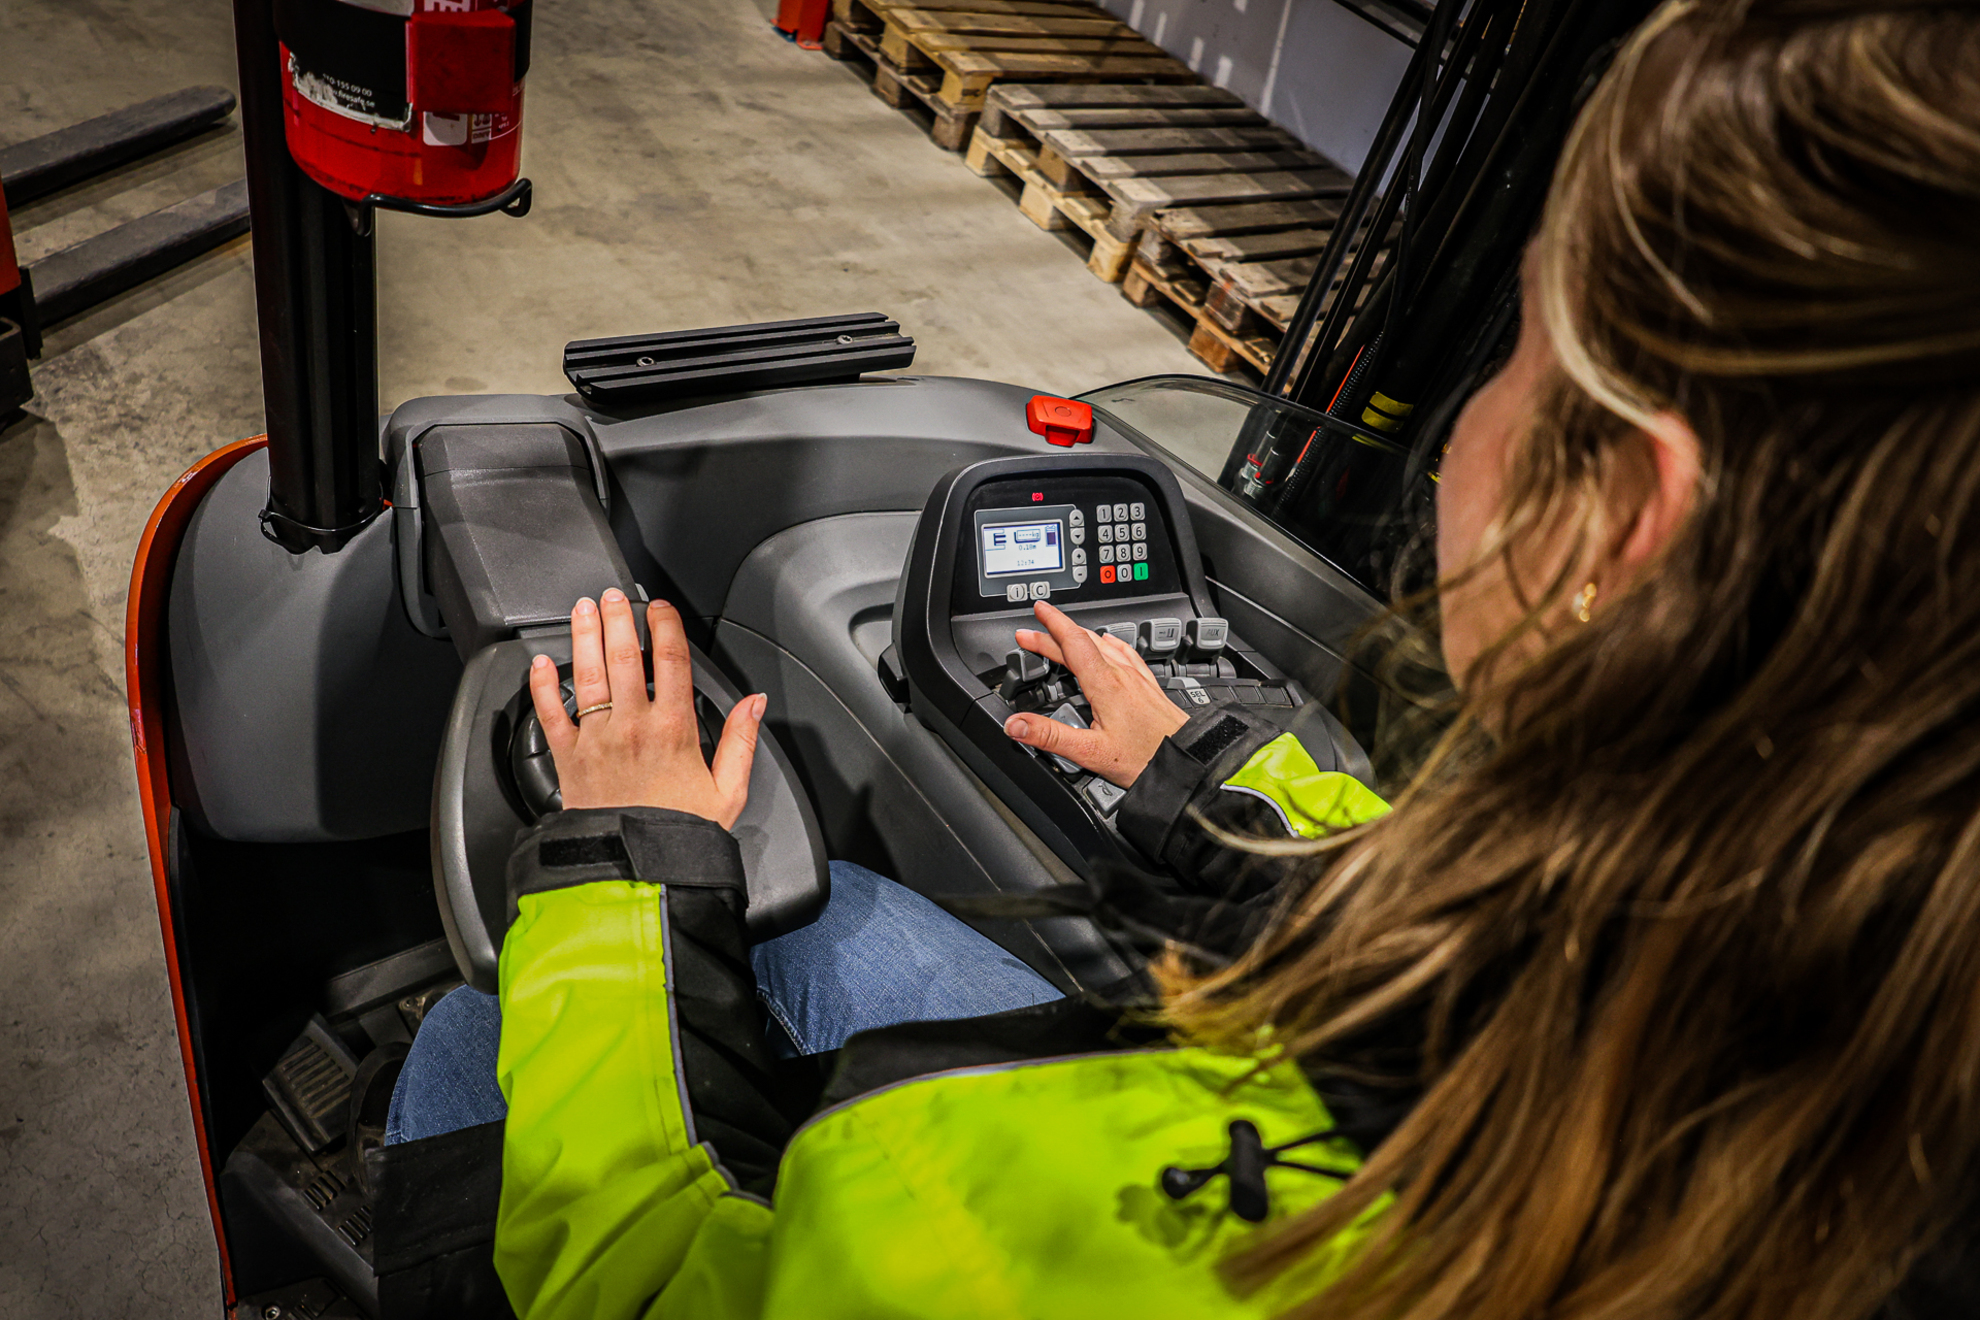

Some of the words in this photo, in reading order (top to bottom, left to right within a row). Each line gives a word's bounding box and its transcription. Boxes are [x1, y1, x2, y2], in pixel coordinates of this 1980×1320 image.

[1117, 507, 1124, 518] 2
[1134, 506, 1141, 517] 3
[1102, 529, 1109, 539] 4
[1119, 527, 1126, 538] 5
[1135, 526, 1142, 537] 6
[1103, 549, 1110, 559] 7
[1120, 548, 1127, 558] 8
[1137, 546, 1143, 557] 9
[1121, 567, 1128, 578] 0
[1036, 585, 1043, 596] C
[1205, 628, 1220, 637] AUX
[1190, 690, 1206, 698] SEL
